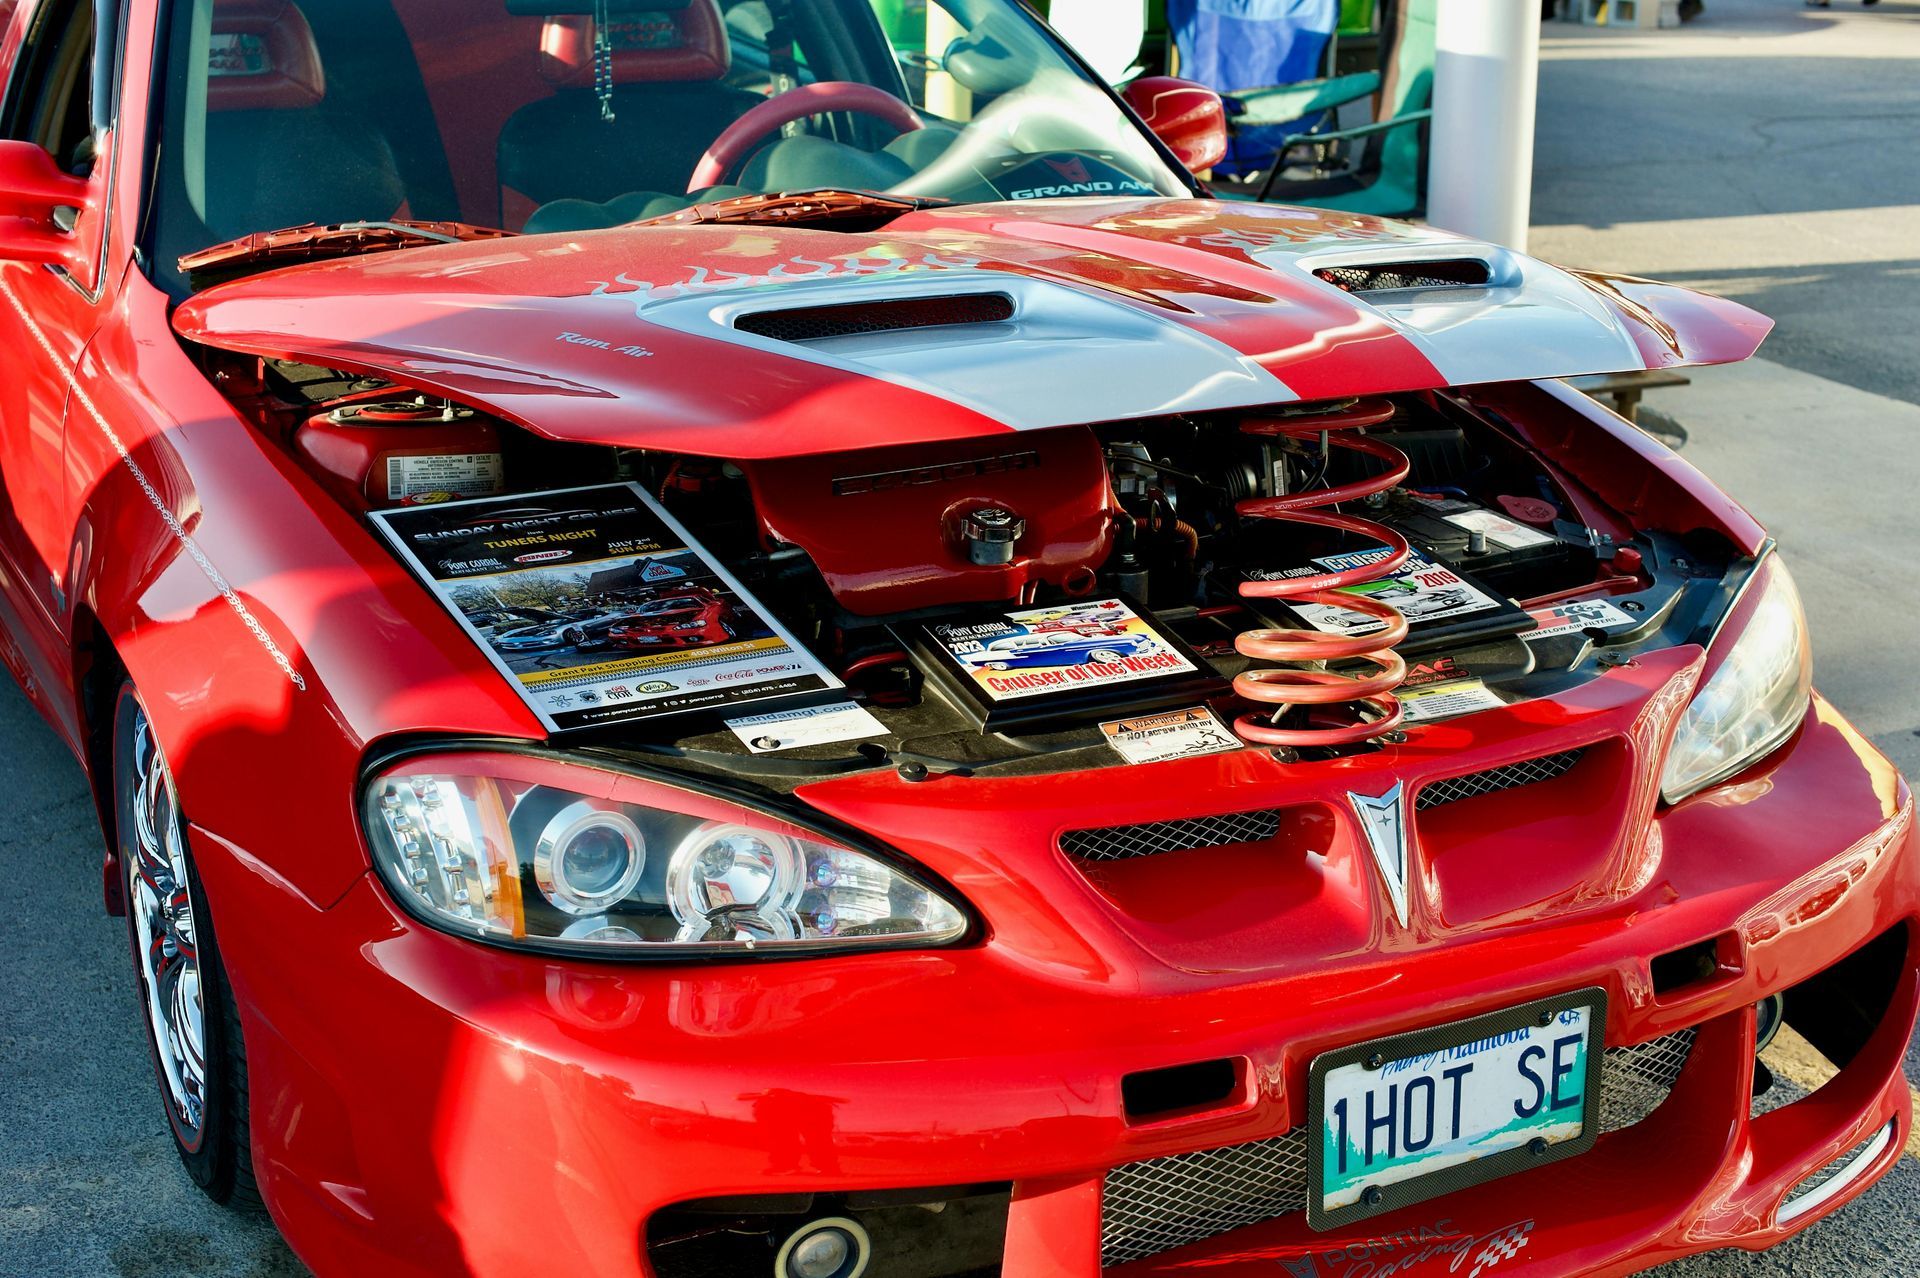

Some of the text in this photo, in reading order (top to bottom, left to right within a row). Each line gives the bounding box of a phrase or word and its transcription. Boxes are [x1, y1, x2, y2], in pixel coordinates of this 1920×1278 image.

[1010, 182, 1113, 200] GRAND
[556, 331, 654, 357] Ram Air
[414, 507, 637, 540] SUNDAY NIGHT CRUISE
[483, 529, 597, 549] TUNERS NIGHT
[635, 537, 650, 545] 2nd
[635, 543, 661, 551] 4PM
[448, 558, 502, 570] PONY CORRAL
[1283, 566, 1320, 578] CORRAL
[1414, 570, 1459, 588] 2019
[947, 622, 1011, 637] PONY CORRAL
[1519, 626, 1567, 639] HIGH-FLOW
[1584, 617, 1617, 628] FILTERS
[948, 640, 985, 655] 2023
[549, 669, 578, 677] Grant
[580, 665, 603, 673] Park
[605, 658, 655, 669] Shopping
[656, 653, 689, 661] Centre
[711, 644, 743, 655] Wilton
[987, 652, 1183, 692] Cruiser of the Week
[1127, 731, 1146, 741] NOT
[1148, 728, 1176, 737] screw
[1178, 722, 1198, 731] with
[1199, 719, 1213, 728] my
[1132, 714, 1181, 728] WARNING
[1334, 1033, 1583, 1174] 1HOT SE
[1322, 1218, 1462, 1268] PONTIAC
